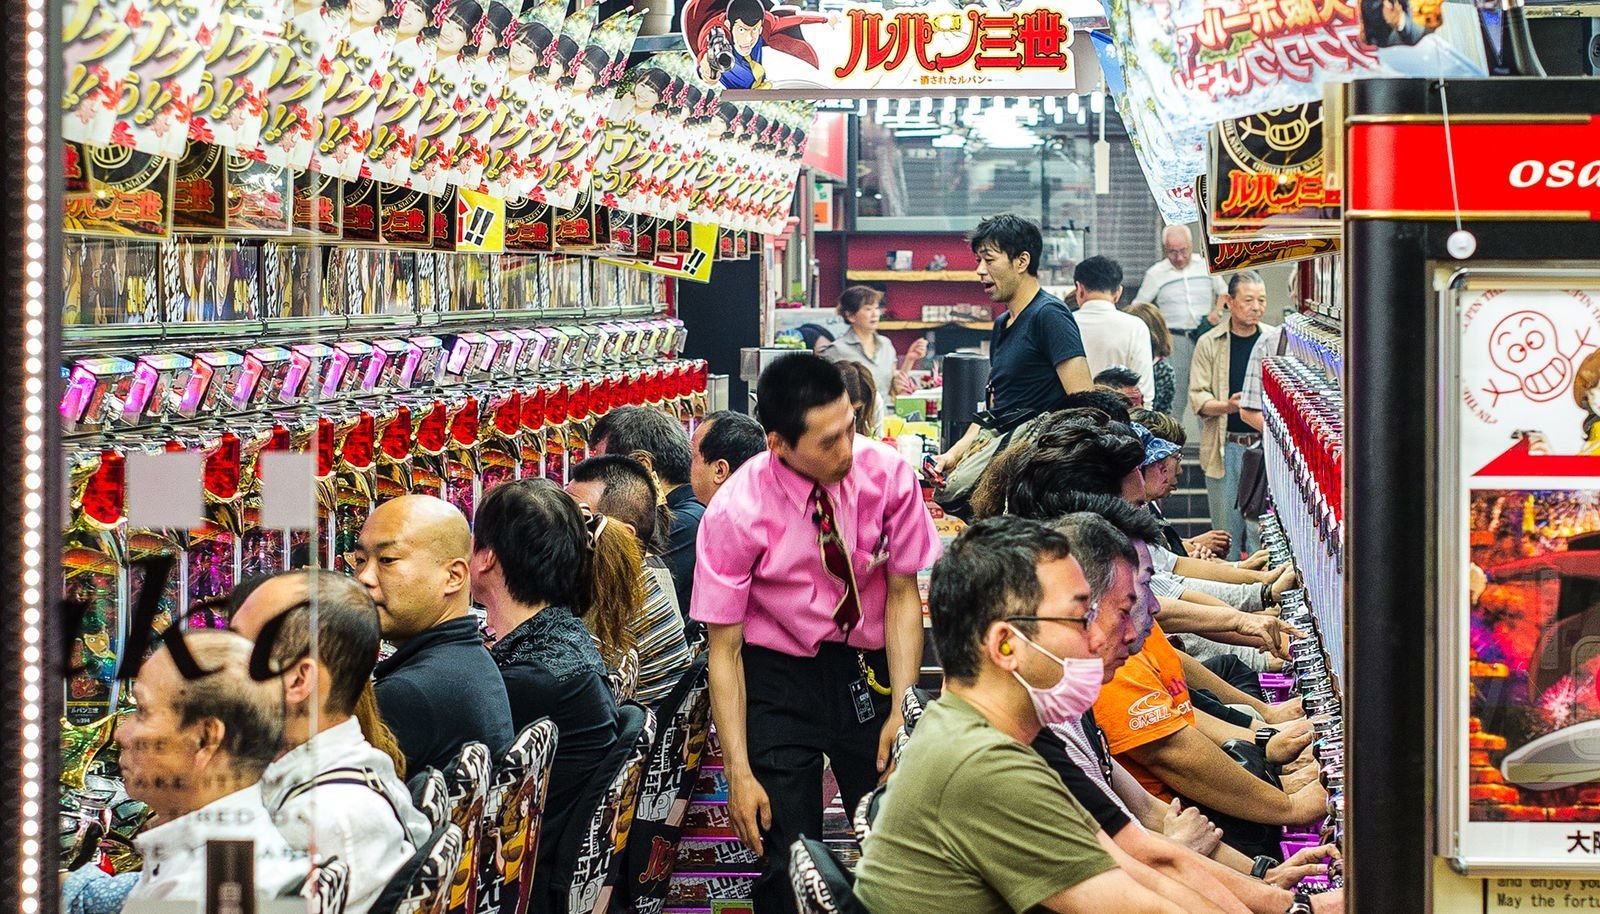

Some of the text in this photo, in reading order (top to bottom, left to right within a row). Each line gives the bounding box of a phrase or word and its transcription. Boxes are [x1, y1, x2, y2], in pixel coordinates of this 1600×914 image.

[834, 9, 1067, 78] ルパン三世
[1497, 893, 1522, 909] May
[1531, 894, 1556, 908] the
